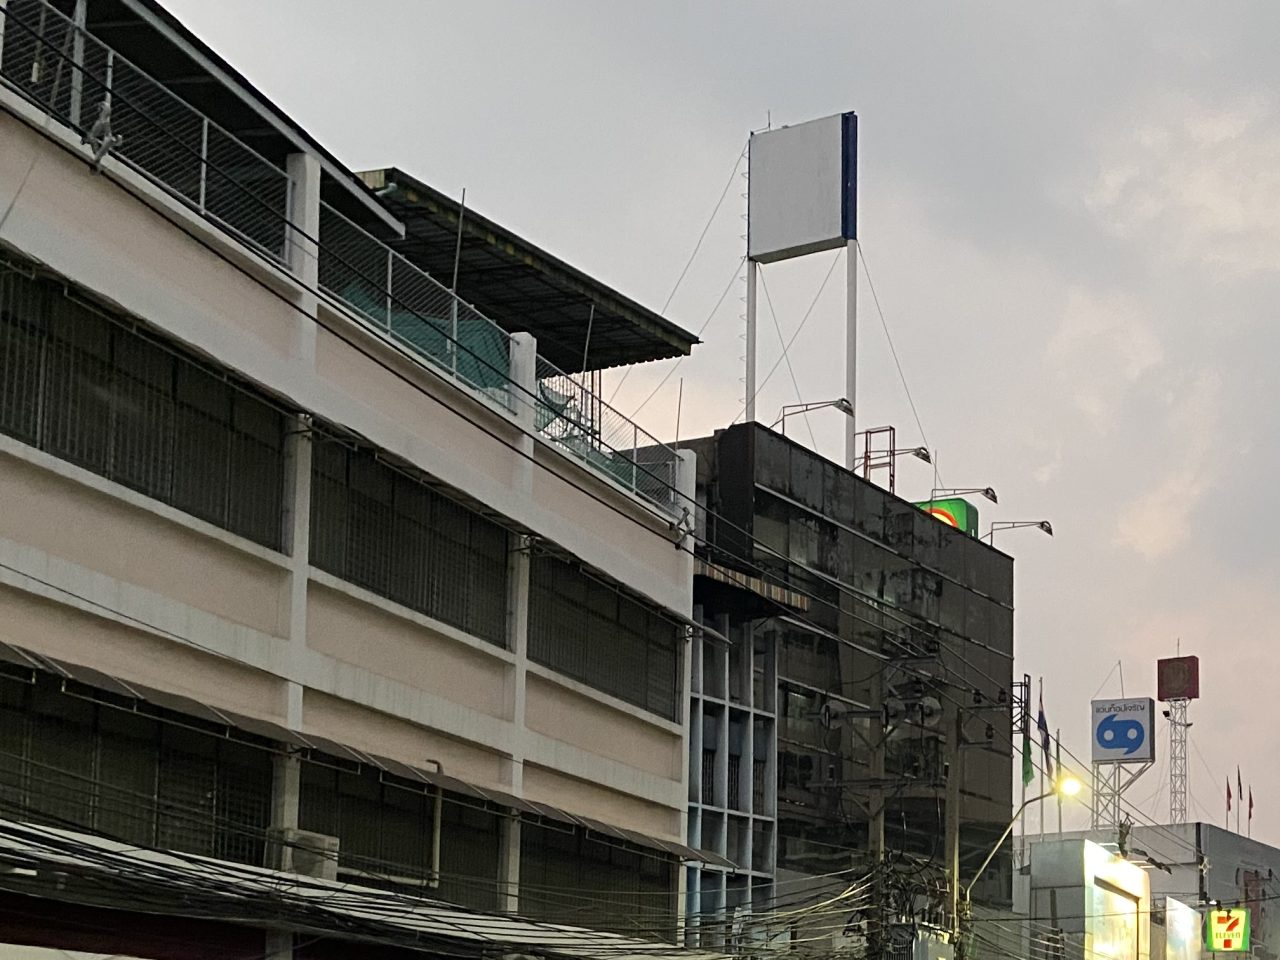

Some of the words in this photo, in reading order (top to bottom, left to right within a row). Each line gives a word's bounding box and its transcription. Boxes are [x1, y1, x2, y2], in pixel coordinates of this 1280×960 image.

[1095, 703, 1145, 713] แว่นท็อปเจริญ
